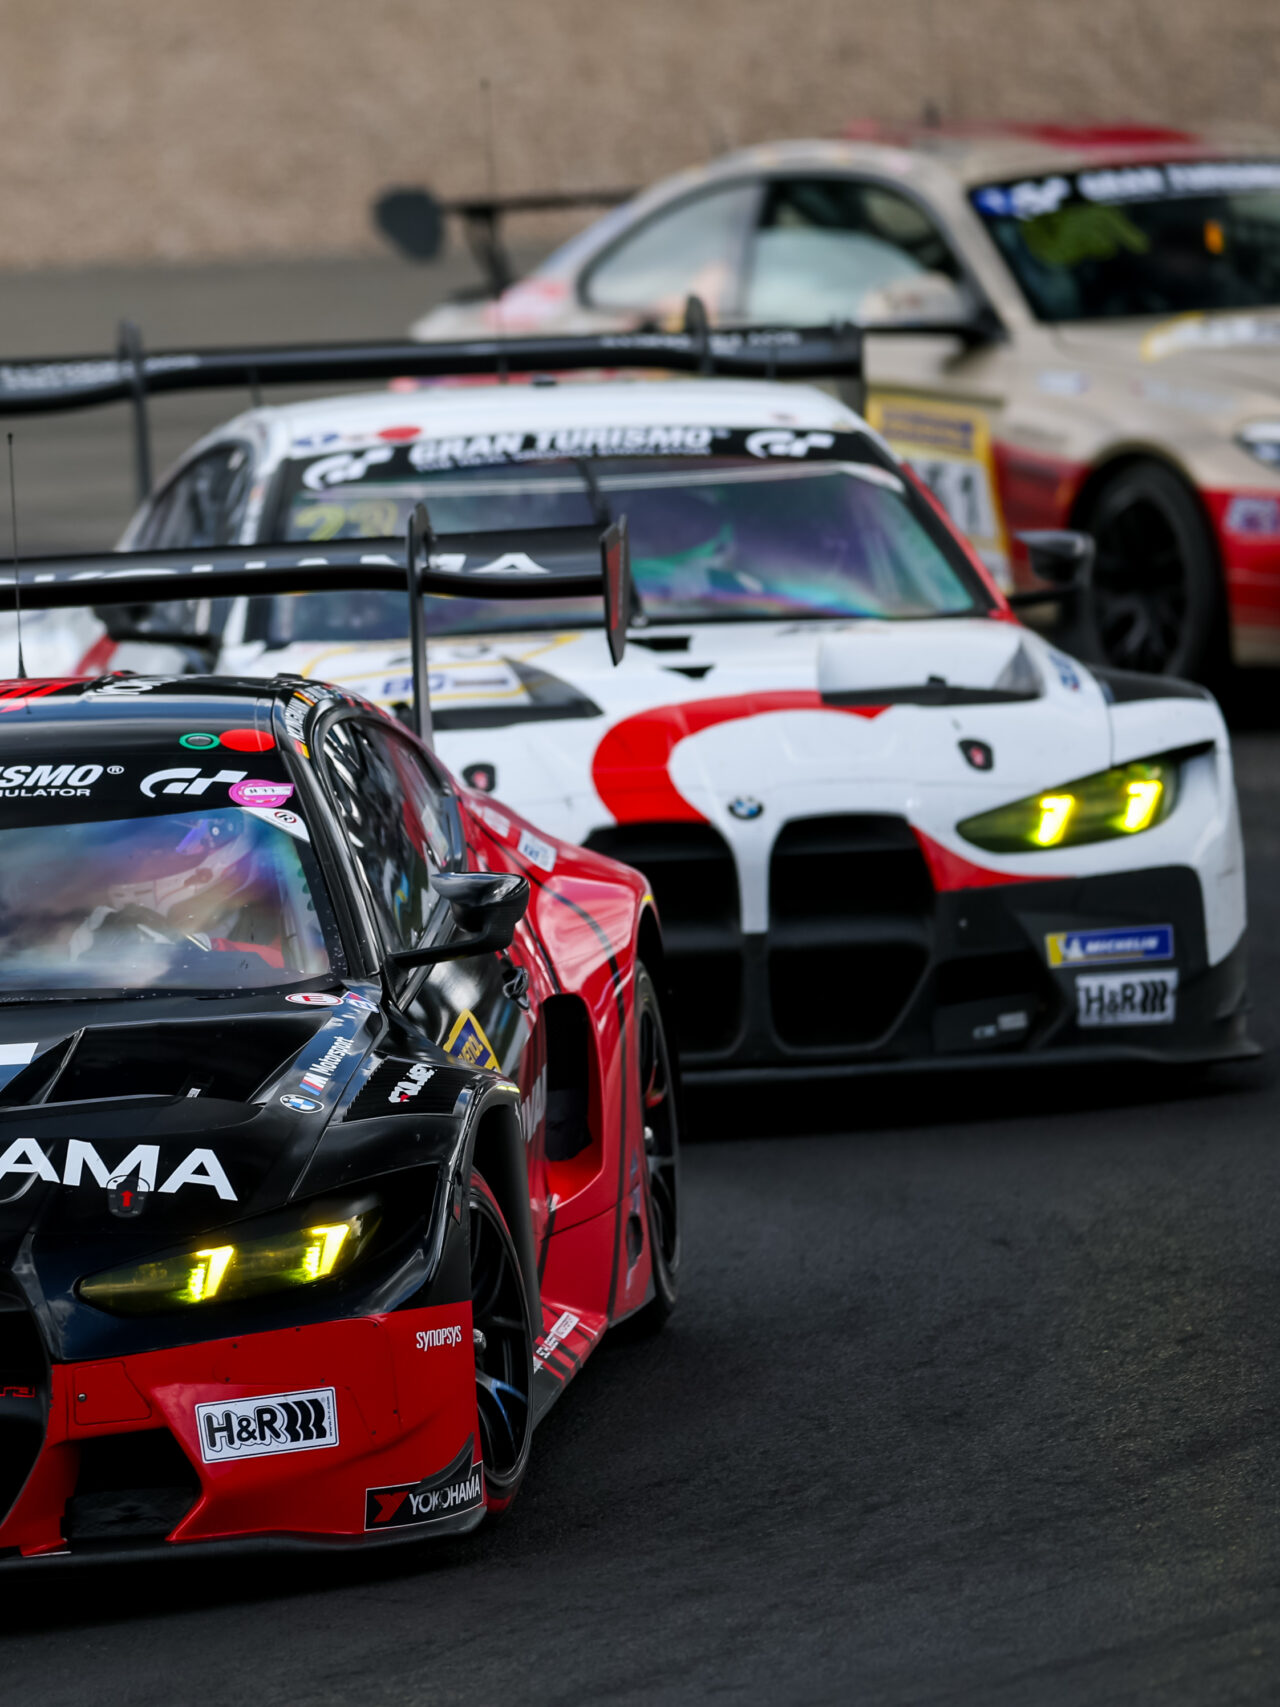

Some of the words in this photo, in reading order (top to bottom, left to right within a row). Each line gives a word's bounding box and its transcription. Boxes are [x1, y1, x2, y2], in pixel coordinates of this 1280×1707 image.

[409, 430, 525, 466] GRAN
[1085, 935, 1160, 954] MICHELIN
[1084, 982, 1138, 1018] H&R
[308, 1035, 355, 1077] Motorsport
[415, 1325, 463, 1352] SYNOPSYS
[204, 1406, 285, 1450] H&R
[408, 1473, 481, 1516] YOKOHAMA
